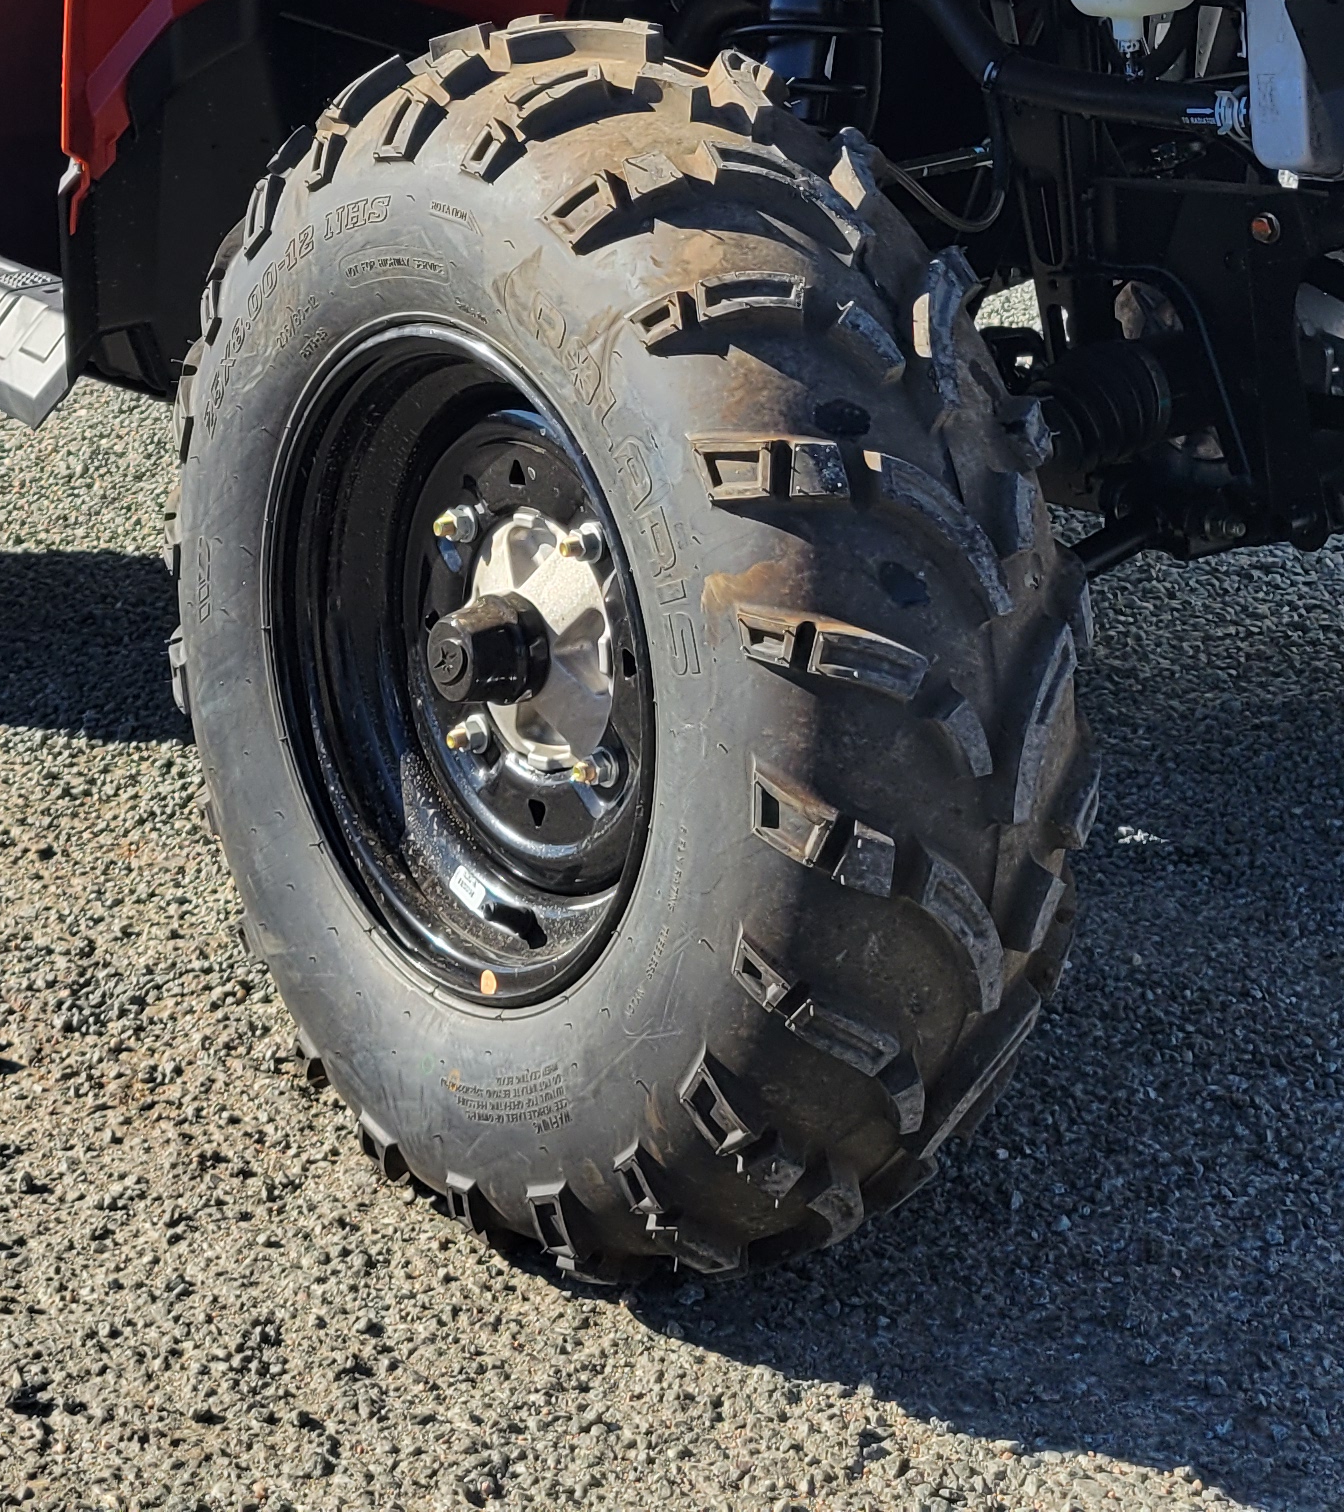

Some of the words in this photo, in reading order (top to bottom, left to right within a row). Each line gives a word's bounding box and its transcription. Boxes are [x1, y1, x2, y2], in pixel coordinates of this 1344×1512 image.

[323, 195, 392, 241] NHS
[430, 201, 468, 221] ROTATION
[534, 291, 703, 677] POLARIS
